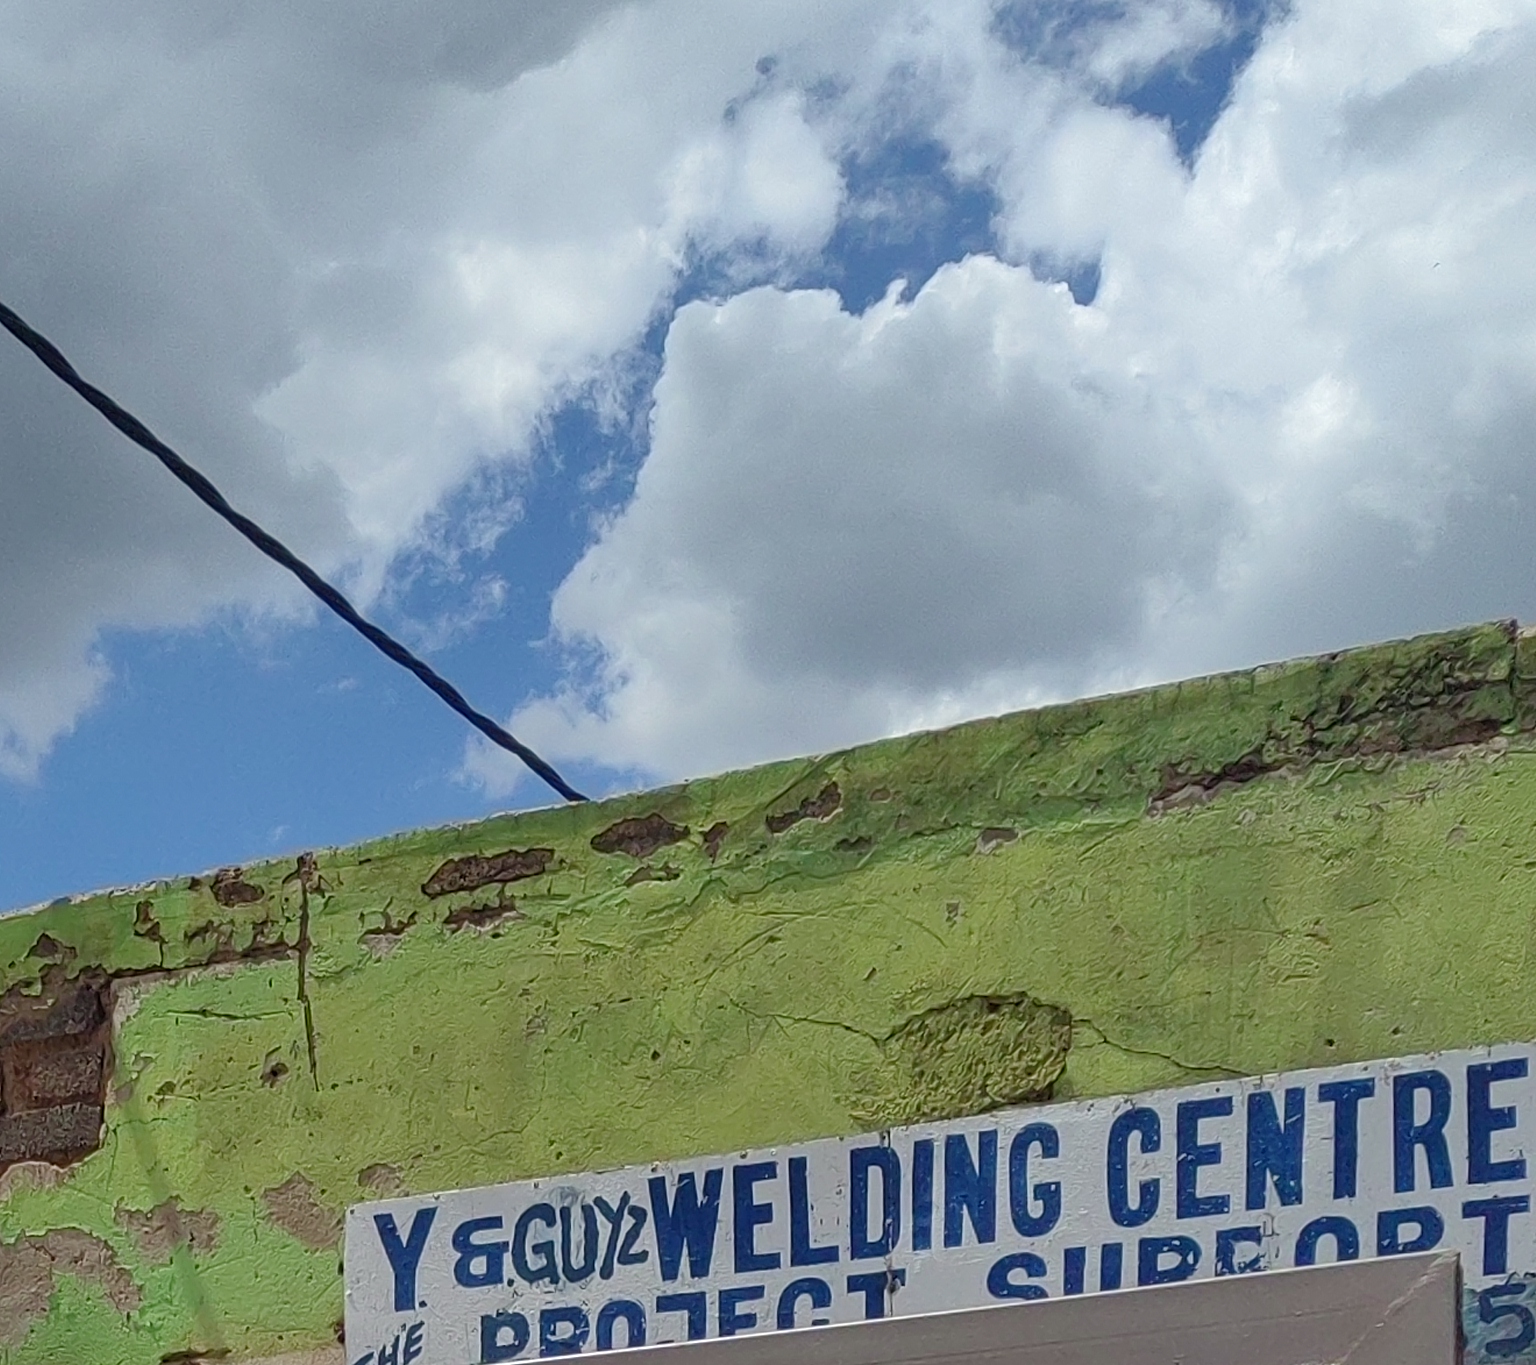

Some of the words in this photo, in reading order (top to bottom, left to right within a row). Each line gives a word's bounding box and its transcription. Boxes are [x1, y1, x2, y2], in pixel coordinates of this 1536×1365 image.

[648, 1121, 1062, 1282] WELDING
[1107, 1057, 1531, 1228] CENTRE
[479, 1268, 906, 1364] PROJECT
